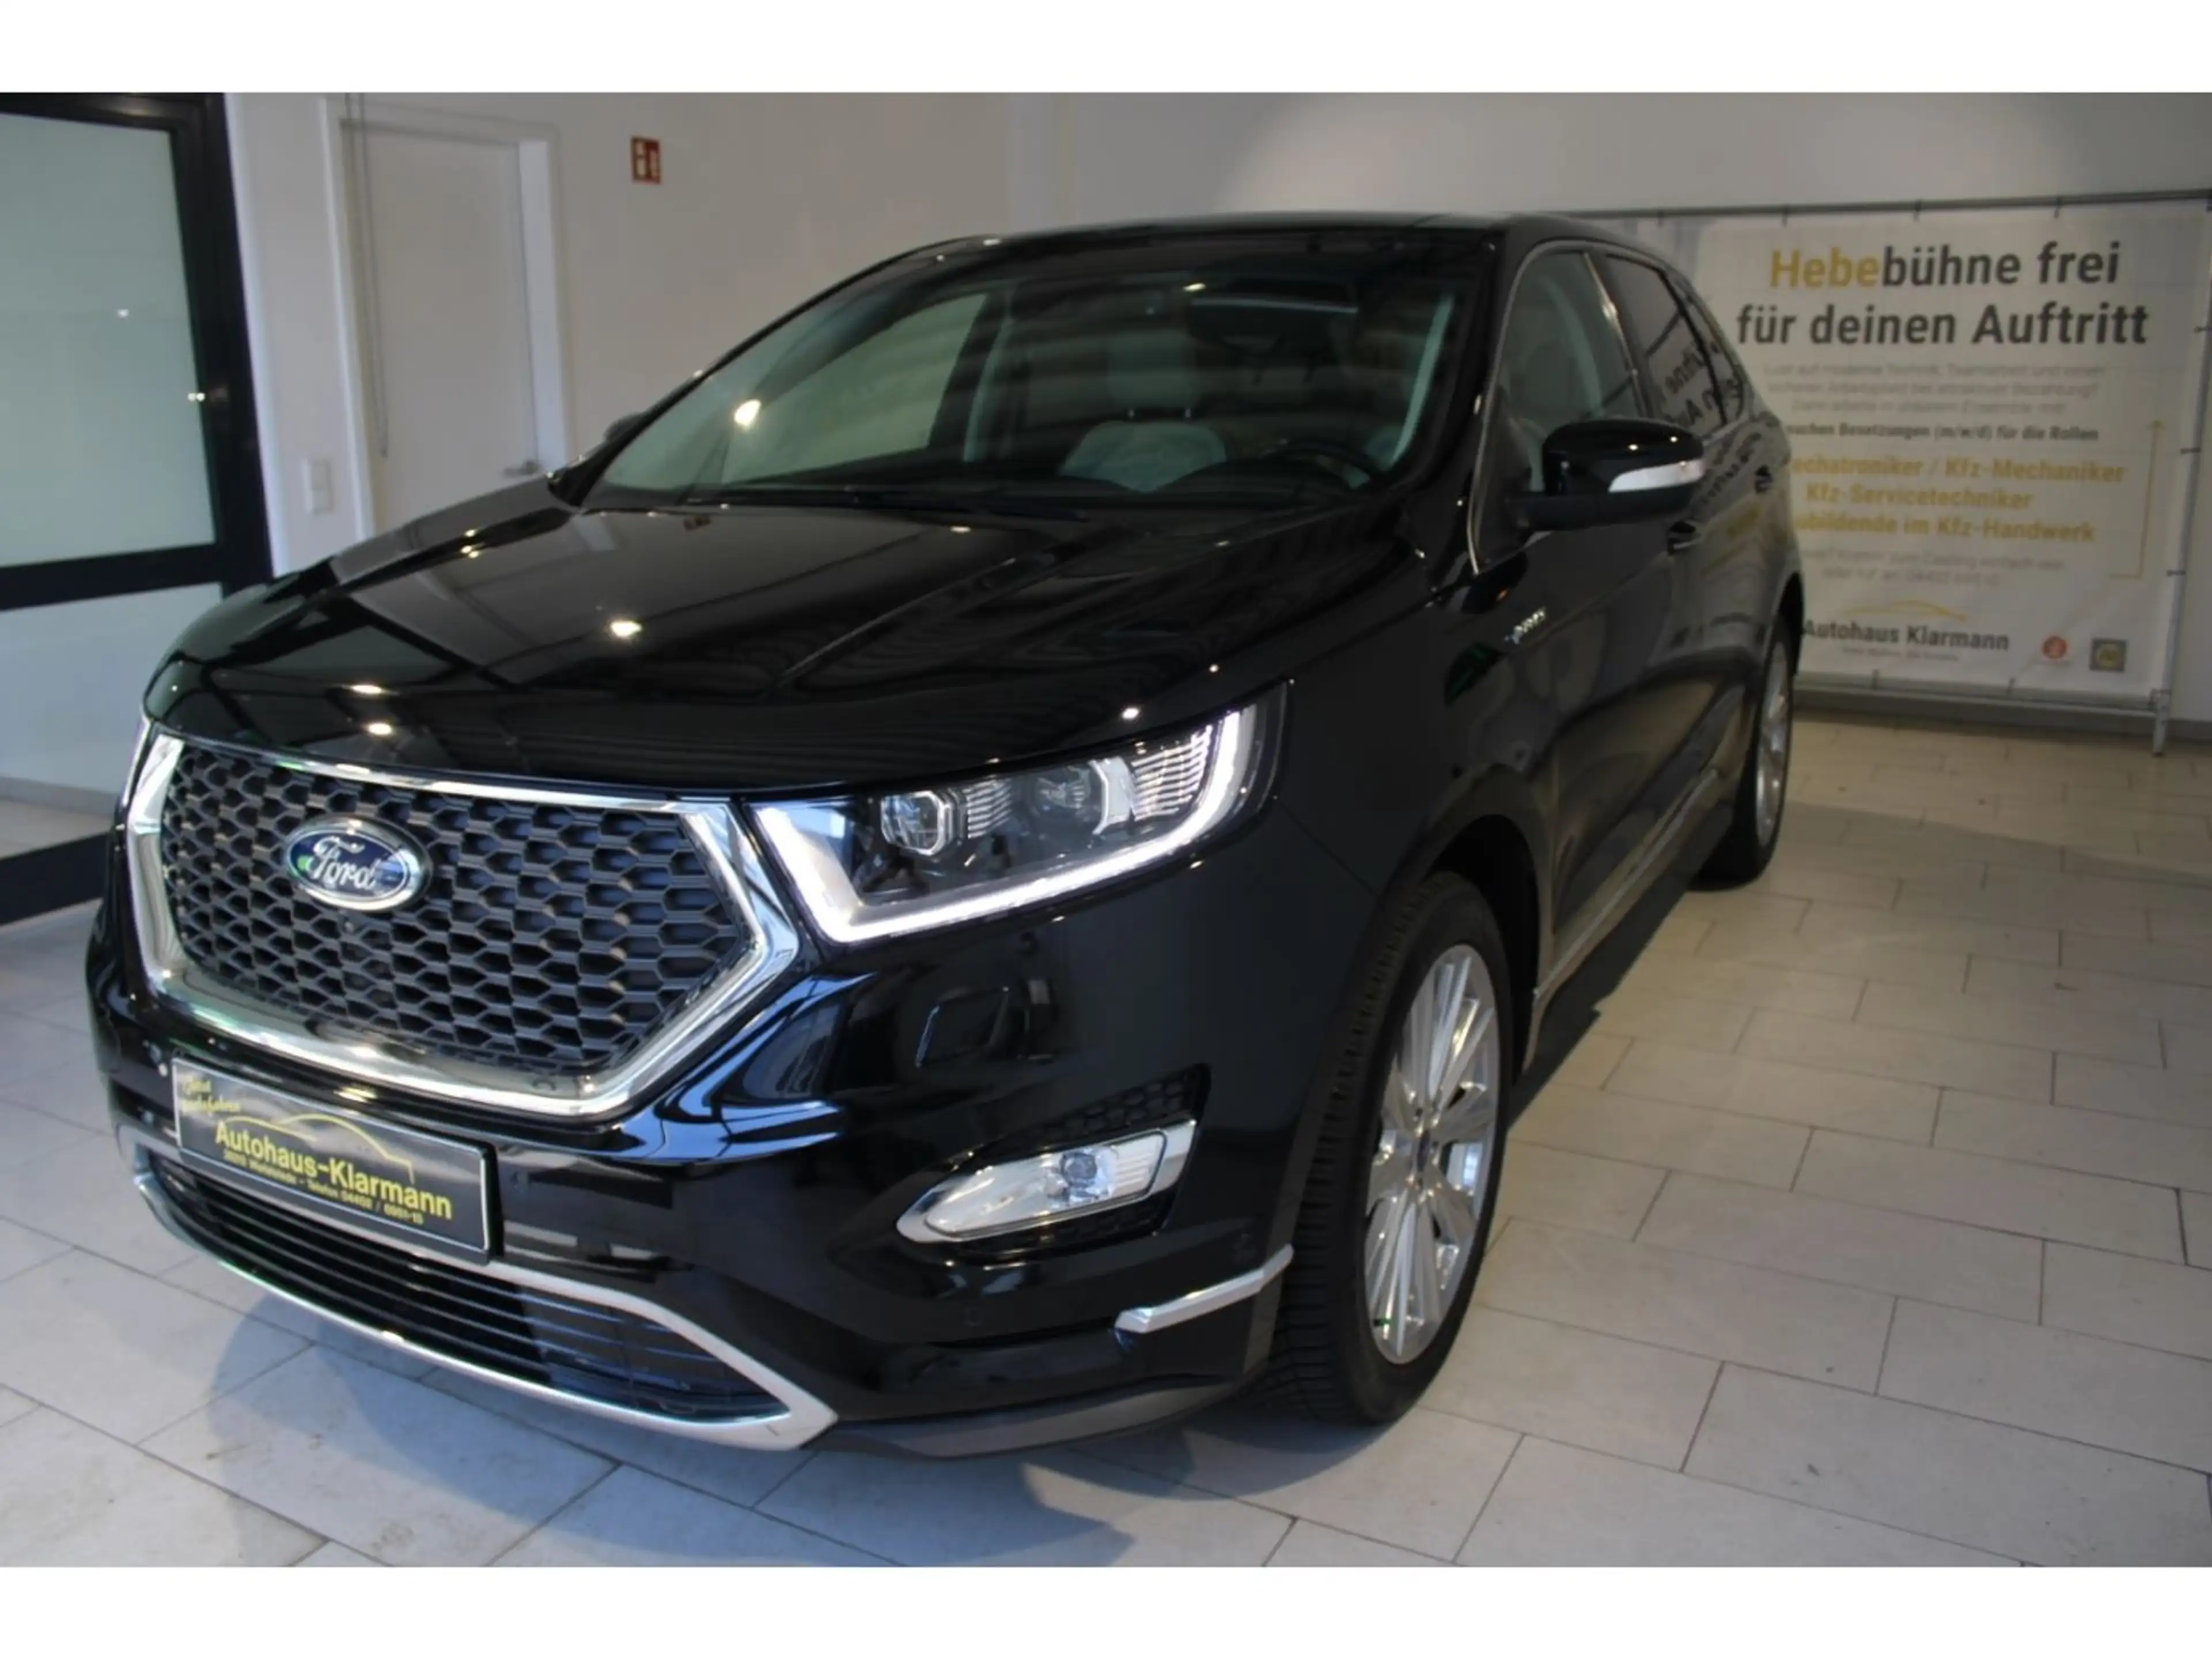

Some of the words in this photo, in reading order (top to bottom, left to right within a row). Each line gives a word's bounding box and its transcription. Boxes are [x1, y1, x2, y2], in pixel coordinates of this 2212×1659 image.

[1770, 245, 2021, 289] Hebebühne
[2037, 241, 2121, 285] frei
[1736, 303, 1796, 345] für
[1809, 304, 1956, 344] deinen
[1972, 302, 2149, 345] Auftritt
[1996, 425, 2018, 440] für
[2022, 425, 2046, 440] die
[2048, 425, 2100, 441] Rollen
[1791, 454, 1924, 476] echatroniker
[1804, 620, 1901, 644] Autohaus
[1906, 624, 2010, 652] Klarmann
[305, 835, 387, 889] Ford
[215, 1120, 452, 1220] Autohaus-Klarmann
